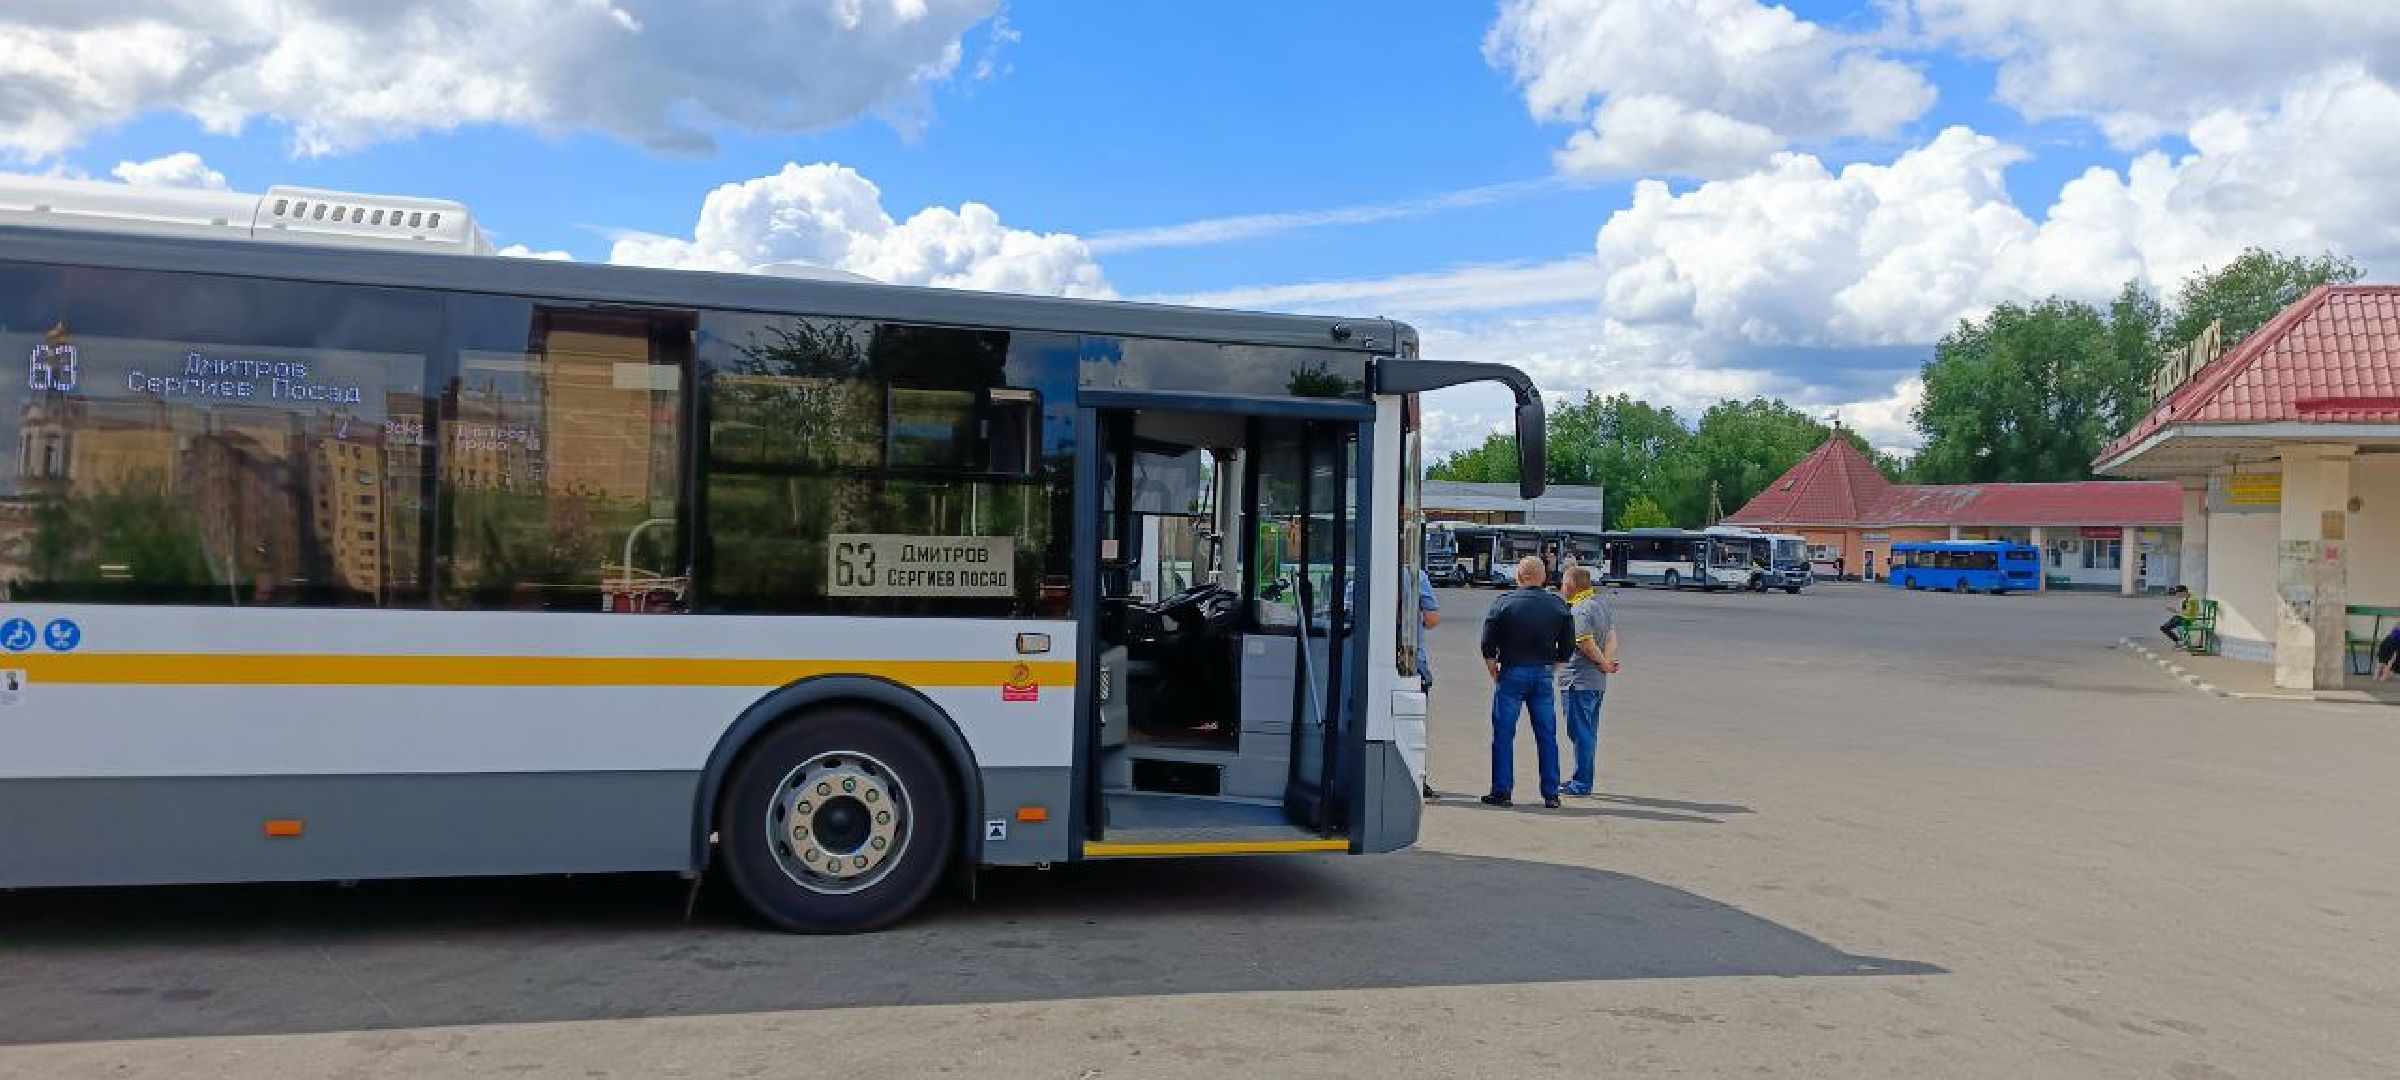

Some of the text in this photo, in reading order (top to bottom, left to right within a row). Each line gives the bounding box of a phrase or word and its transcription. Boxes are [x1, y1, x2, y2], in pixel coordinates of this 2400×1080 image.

[28, 344, 77, 392] 63
[183, 350, 308, 378] Дмитров
[127, 370, 361, 404] Сергиев Посад
[836, 542, 876, 587] 63
[887, 569, 1007, 588] СЕРГИЕВ ПОСАД
